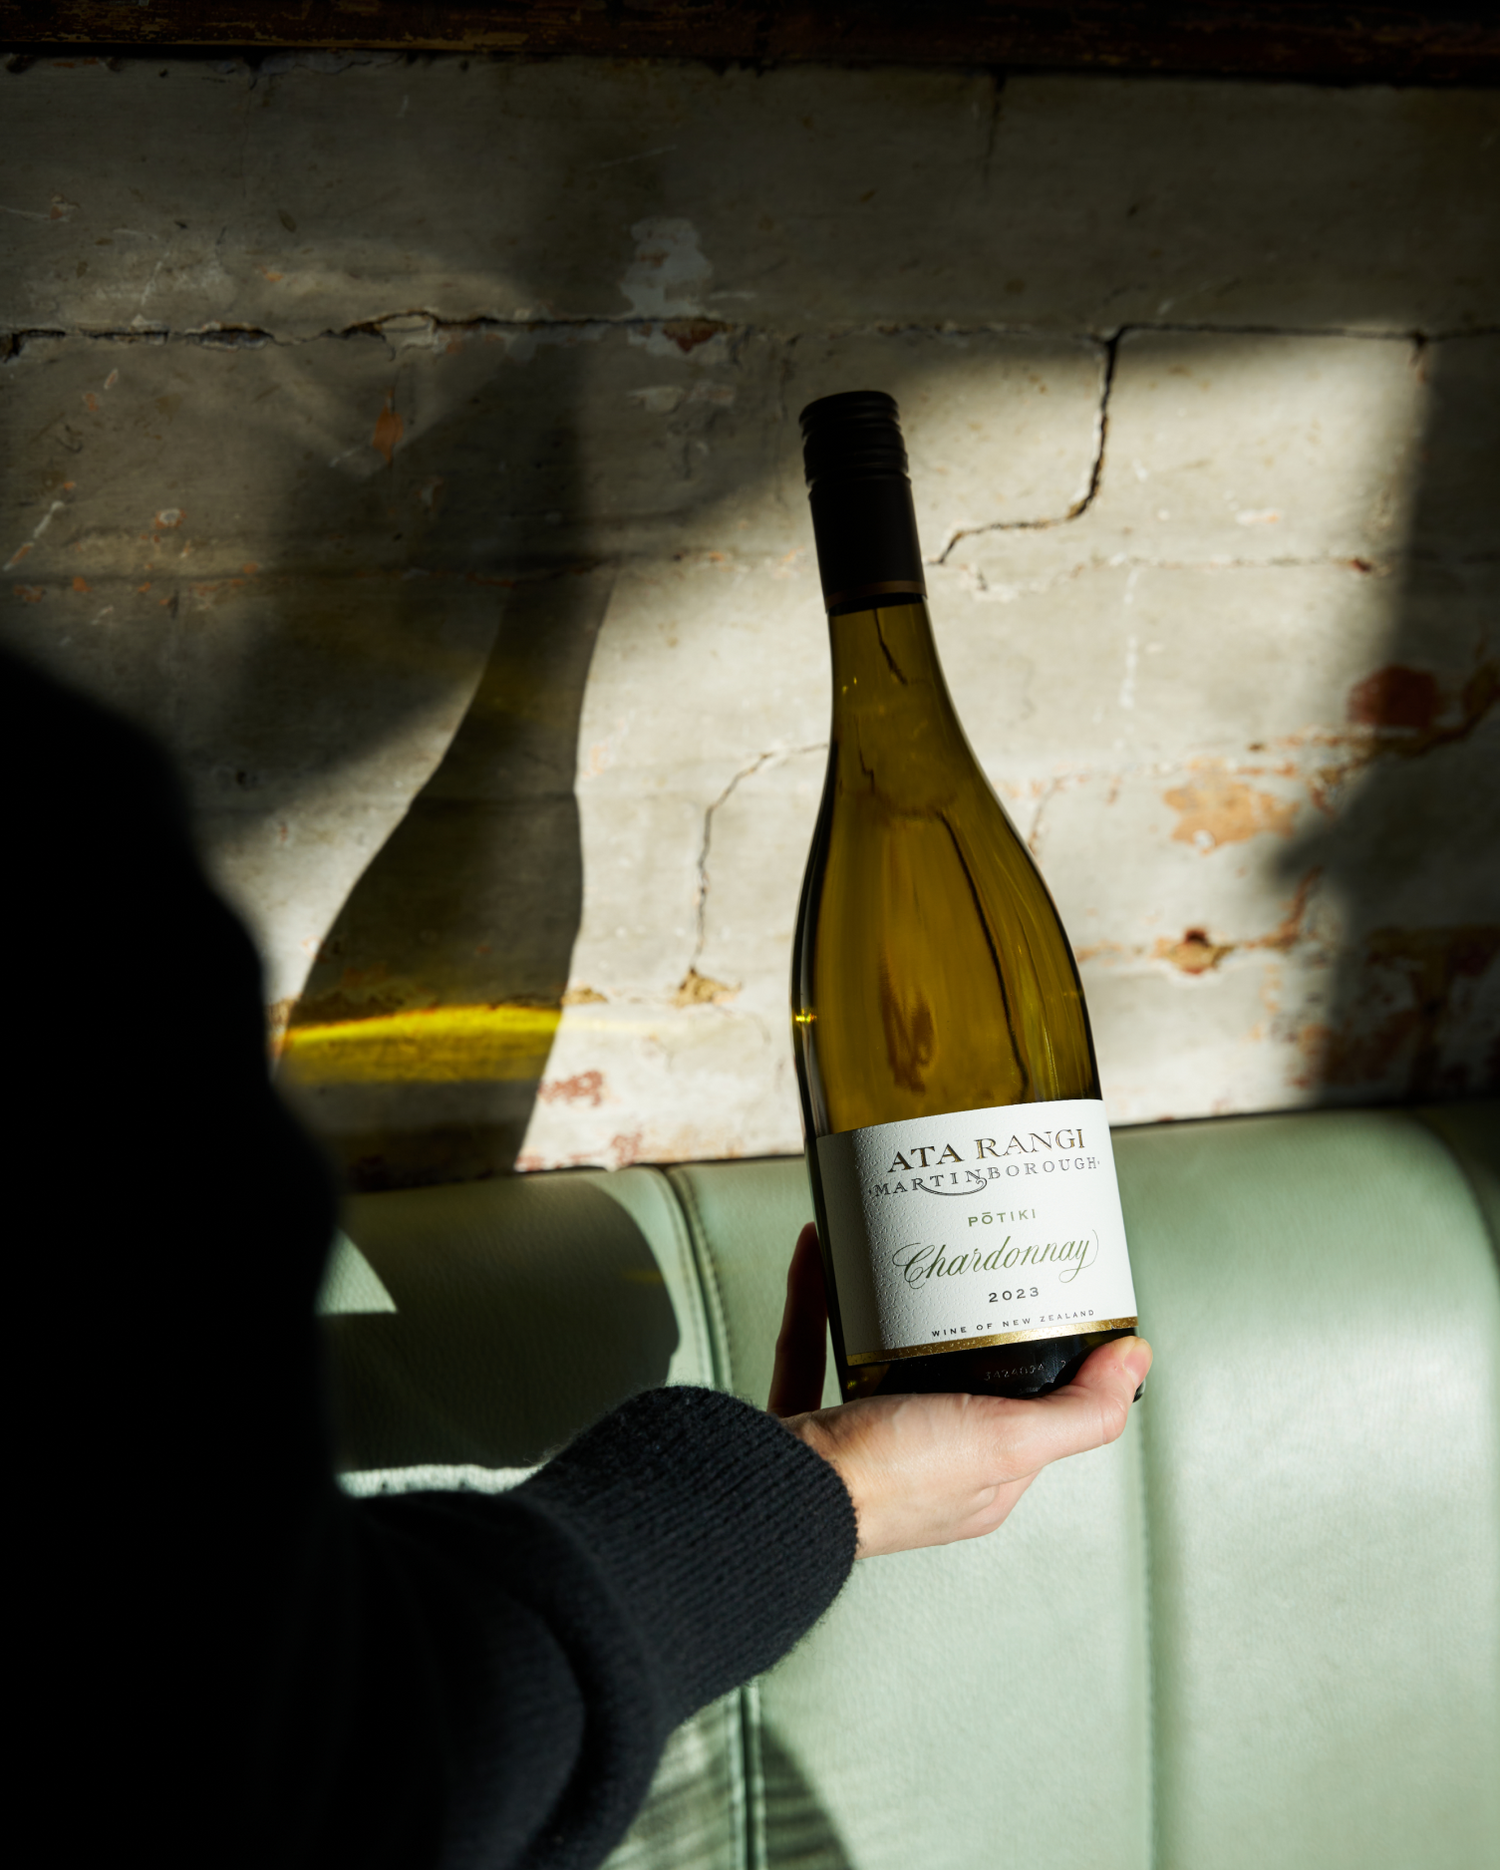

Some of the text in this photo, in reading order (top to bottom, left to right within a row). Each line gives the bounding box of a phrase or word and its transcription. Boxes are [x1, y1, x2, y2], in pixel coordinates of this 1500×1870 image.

[887, 1128, 1086, 1174] ATA RANGI
[967, 1208, 1037, 1228] PŌTIKI
[891, 1229, 1099, 1290] Chardonnay
[988, 1286, 1040, 1304] 2023
[931, 1309, 1095, 1338] WINE OF NEW ZEALAND
